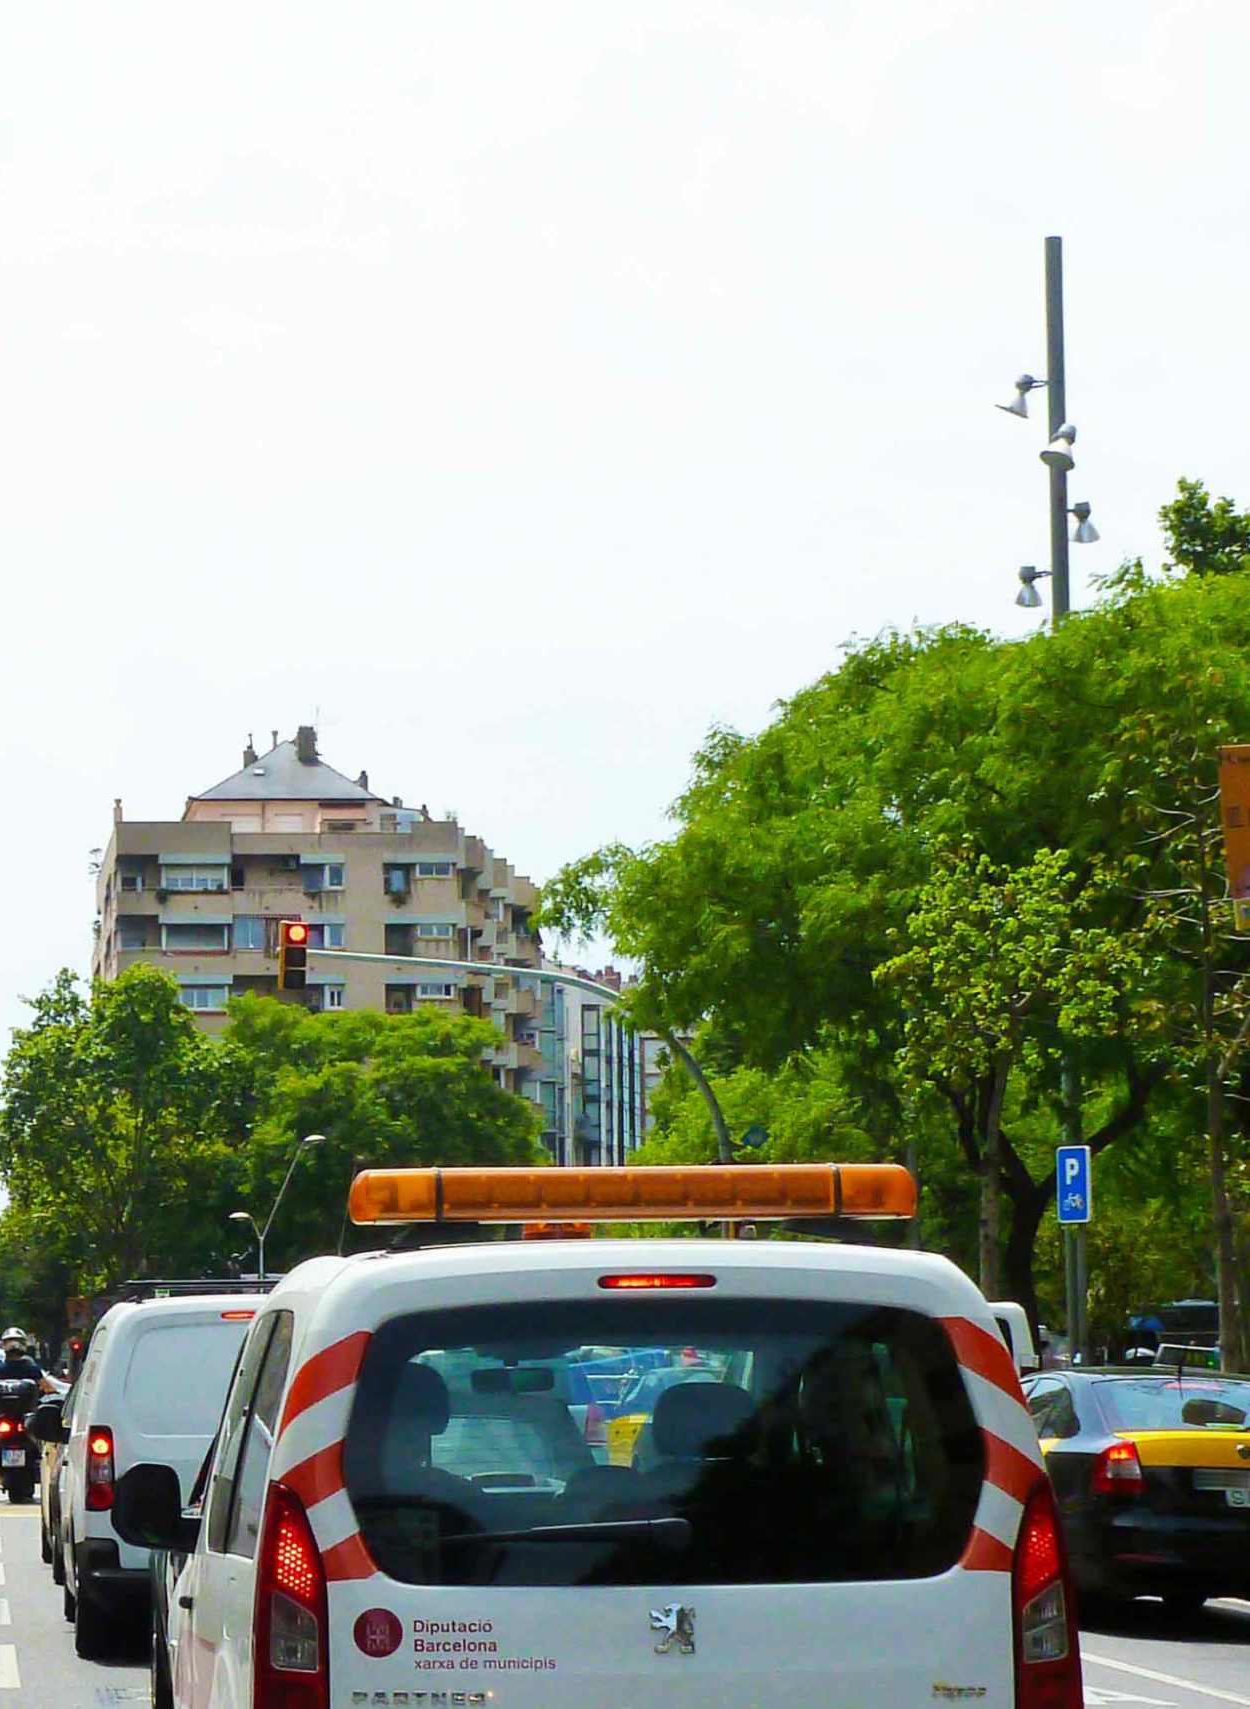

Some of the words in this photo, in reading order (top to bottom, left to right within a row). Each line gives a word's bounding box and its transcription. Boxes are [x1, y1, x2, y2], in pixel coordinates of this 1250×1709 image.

[1065, 1158, 1080, 1185] P
[413, 1619, 493, 1636] Diputació
[414, 1639, 497, 1653] Barcelona
[415, 1659, 455, 1670] xarxa
[459, 1657, 479, 1670] de
[483, 1657, 557, 1673] municipis
